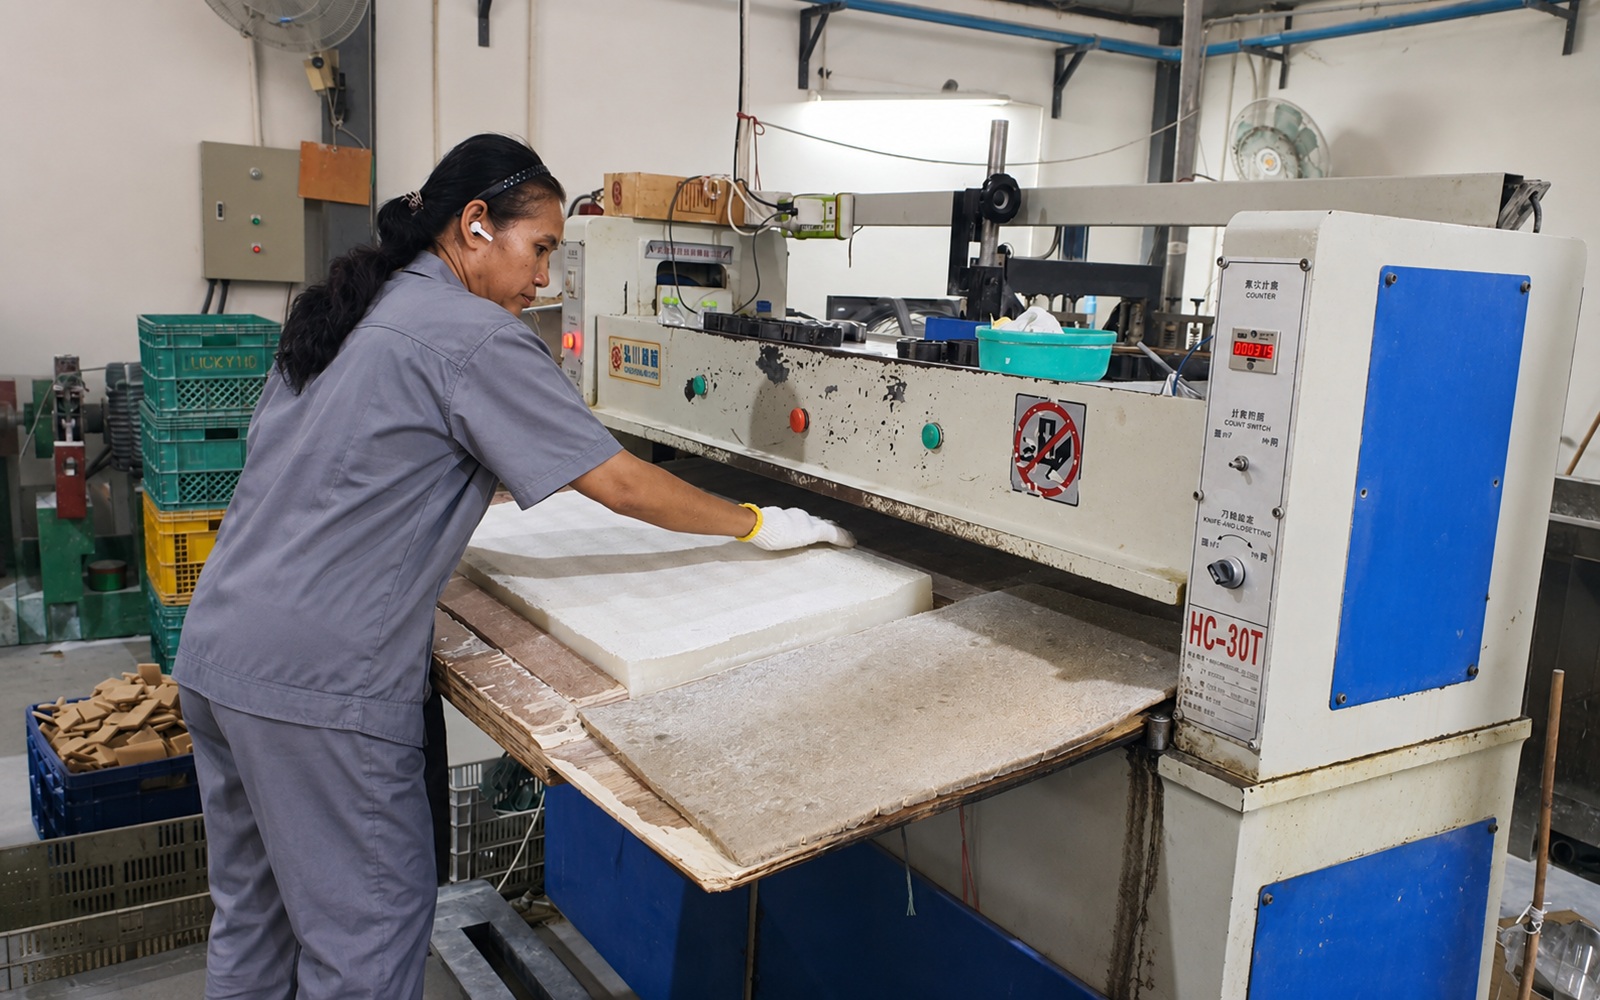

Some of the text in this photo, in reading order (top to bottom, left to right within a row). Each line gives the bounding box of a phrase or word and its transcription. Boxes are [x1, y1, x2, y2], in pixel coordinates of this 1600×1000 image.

[1224, 419, 1271, 432] COUNT SWITCH
[1189, 611, 1263, 665] HC-30T
